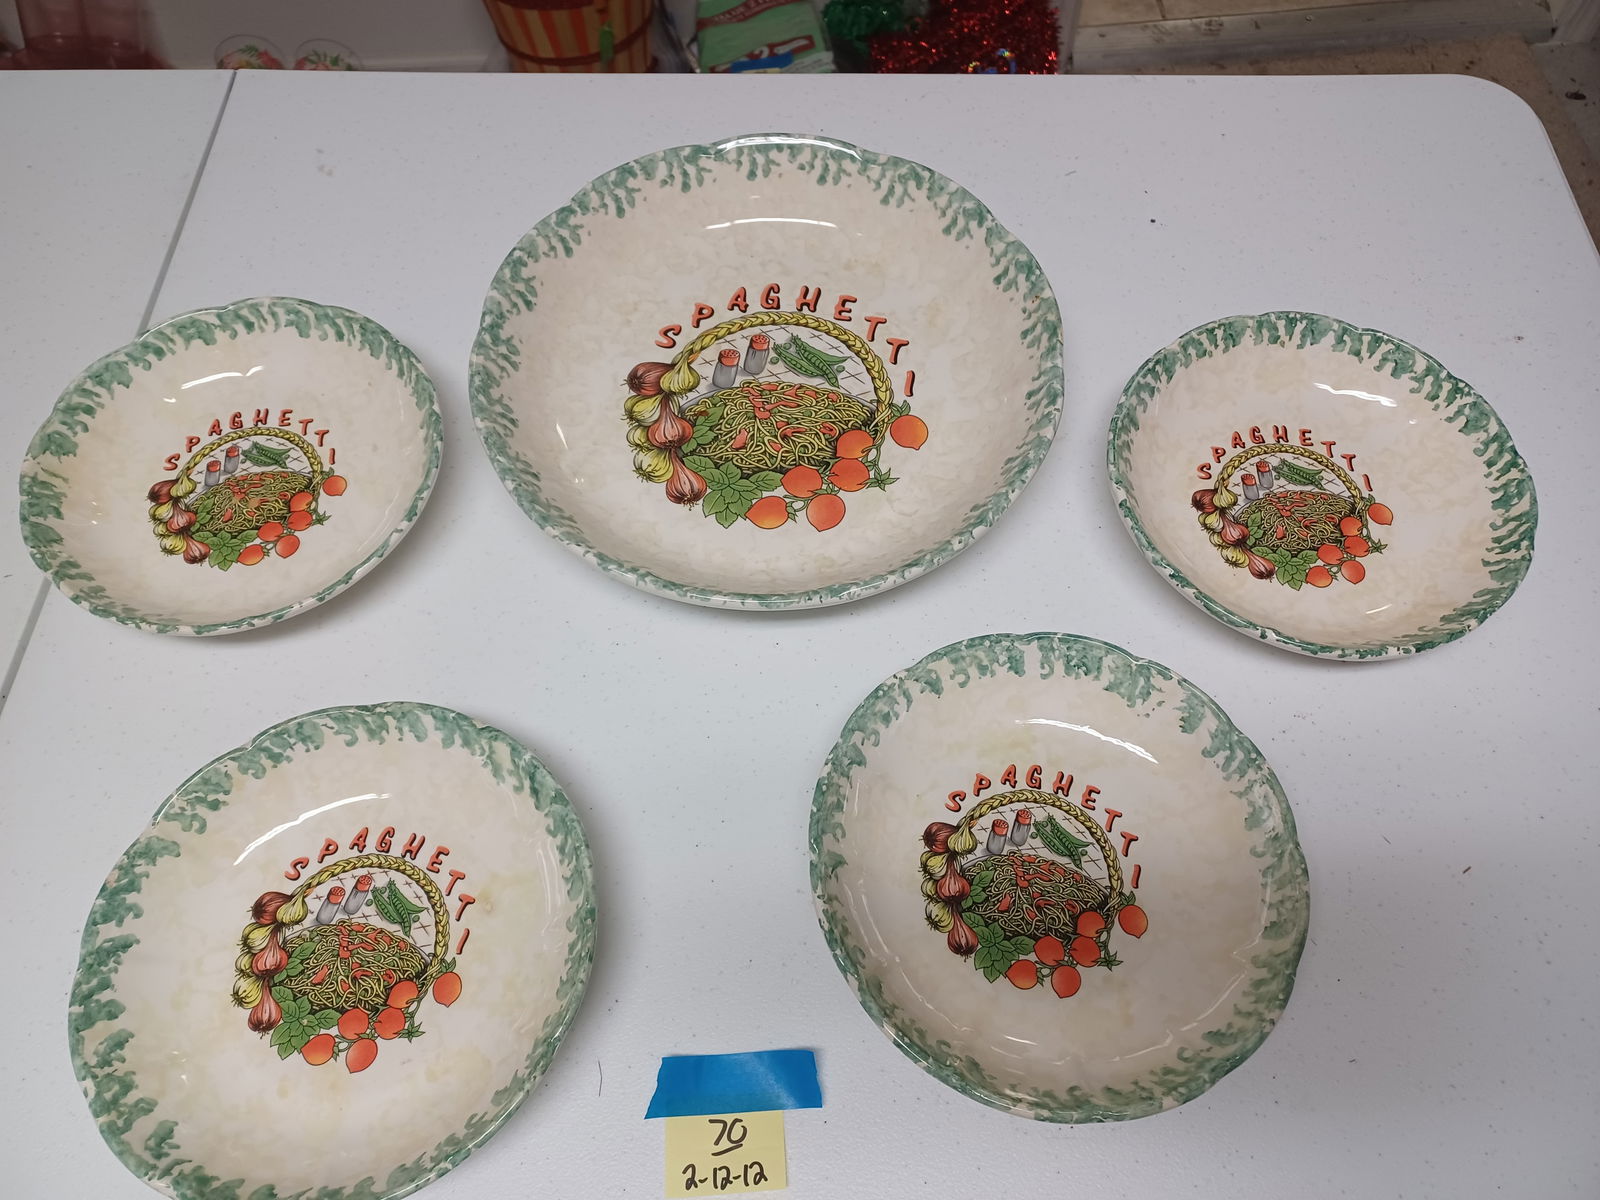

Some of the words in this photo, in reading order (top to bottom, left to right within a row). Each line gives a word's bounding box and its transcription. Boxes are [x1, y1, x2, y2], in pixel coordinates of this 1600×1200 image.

[655, 283, 916, 398] SPAGHETTI
[163, 408, 336, 471] SPAGHETTI
[1196, 424, 1373, 492] SPAGHETTI
[945, 764, 1142, 889] SPAGHETTI
[284, 826, 476, 955] SPAGHETTI
[708, 1117, 748, 1147] 70
[682, 1161, 768, 1191] 2-12-12
